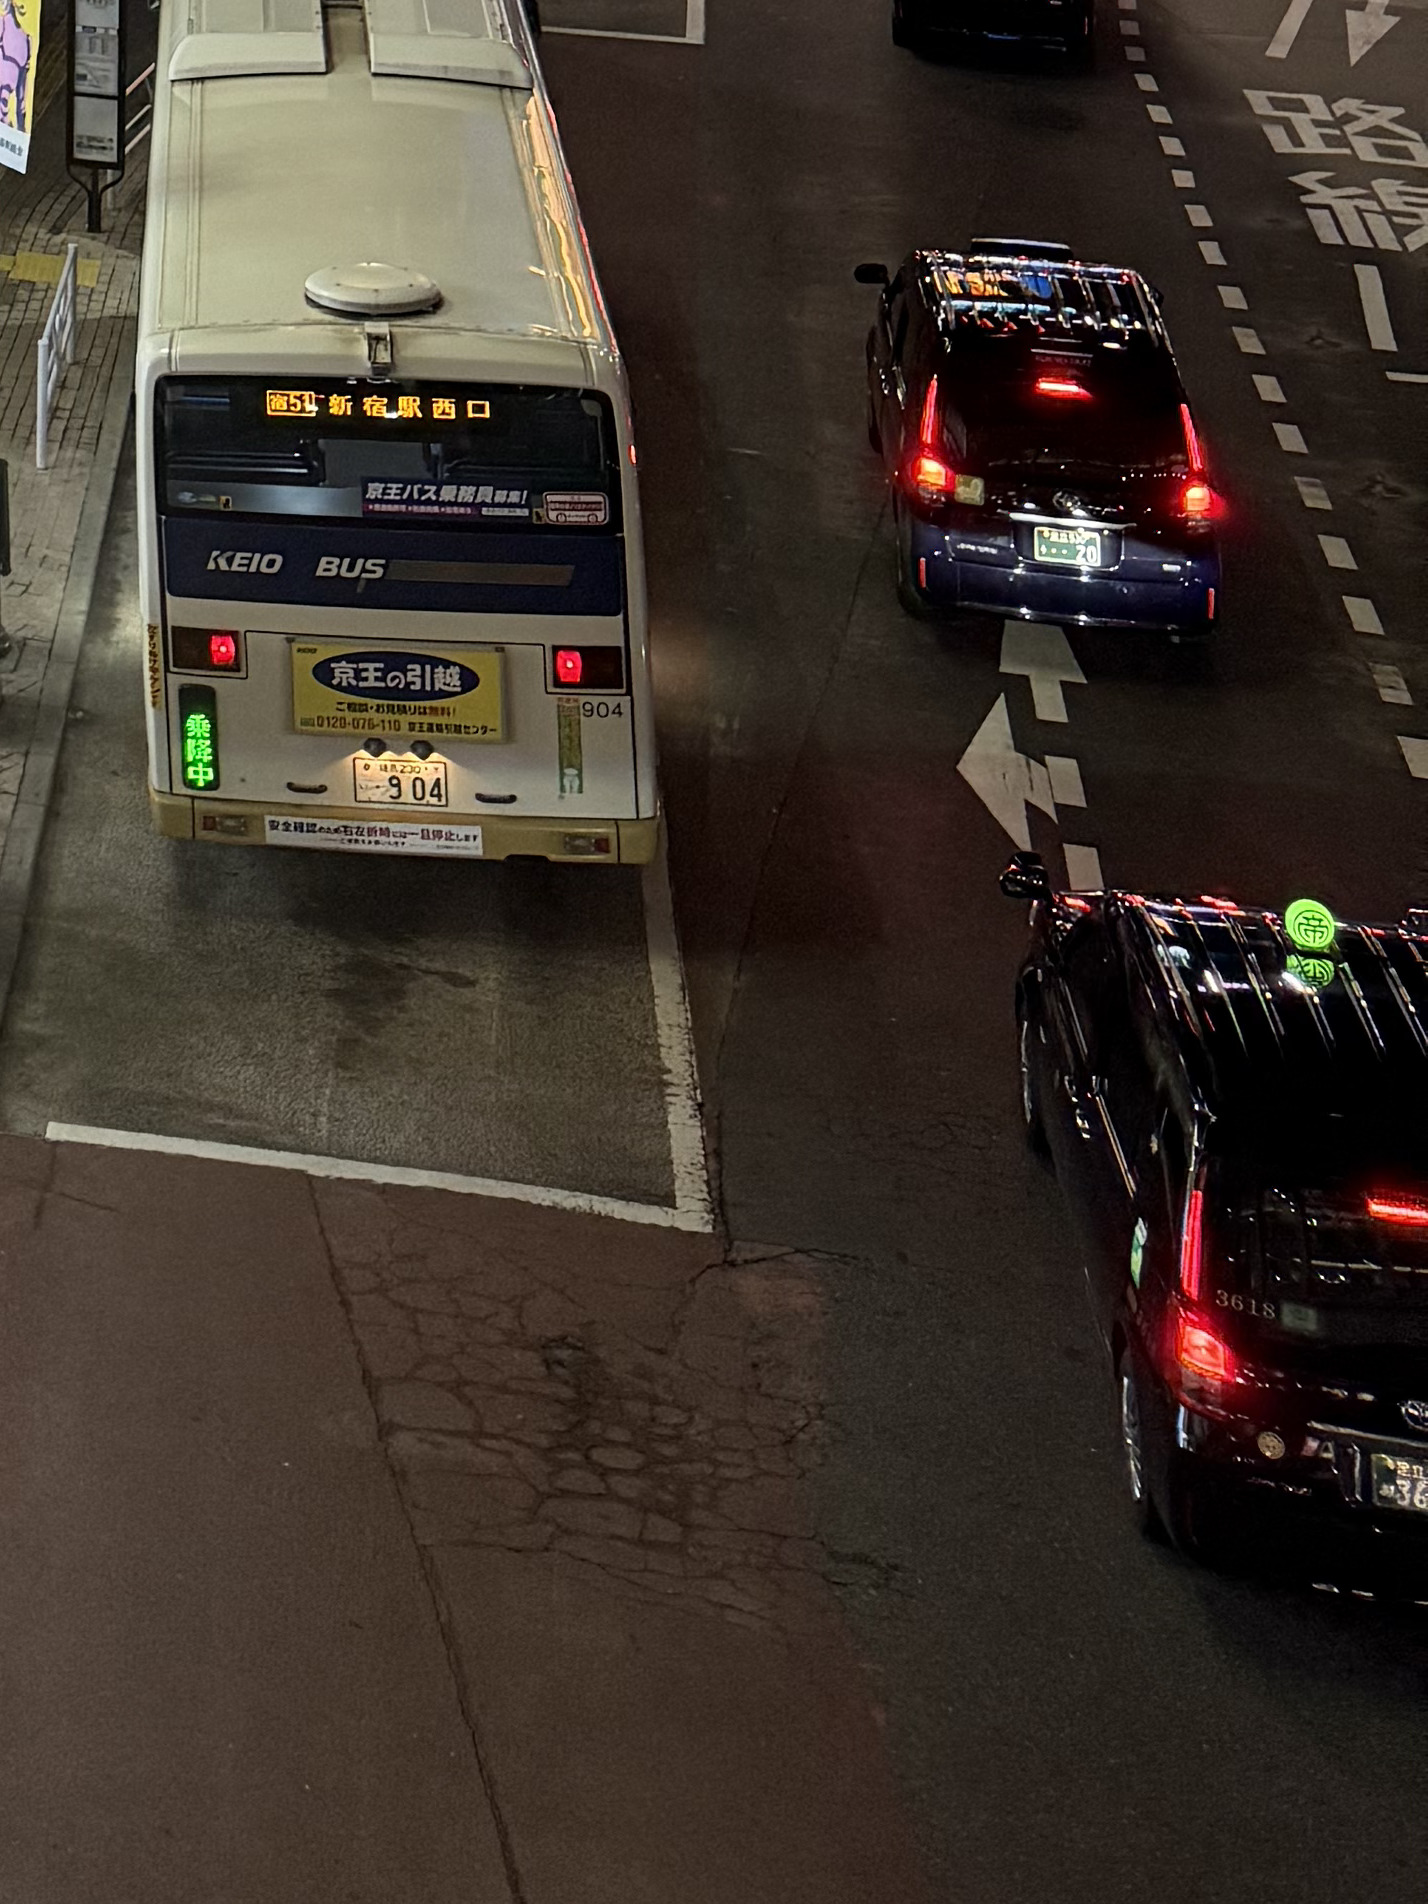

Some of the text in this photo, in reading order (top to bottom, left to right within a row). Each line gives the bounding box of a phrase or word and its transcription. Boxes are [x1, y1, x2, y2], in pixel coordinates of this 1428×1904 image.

[328, 395, 491, 420] 新宿駅西口
[207, 550, 386, 579] KEIO BUS
[330, 660, 463, 693] 京王の引越
[581, 700, 624, 719] 904
[186, 713, 214, 787] 乗降中
[387, 775, 443, 803] 904
